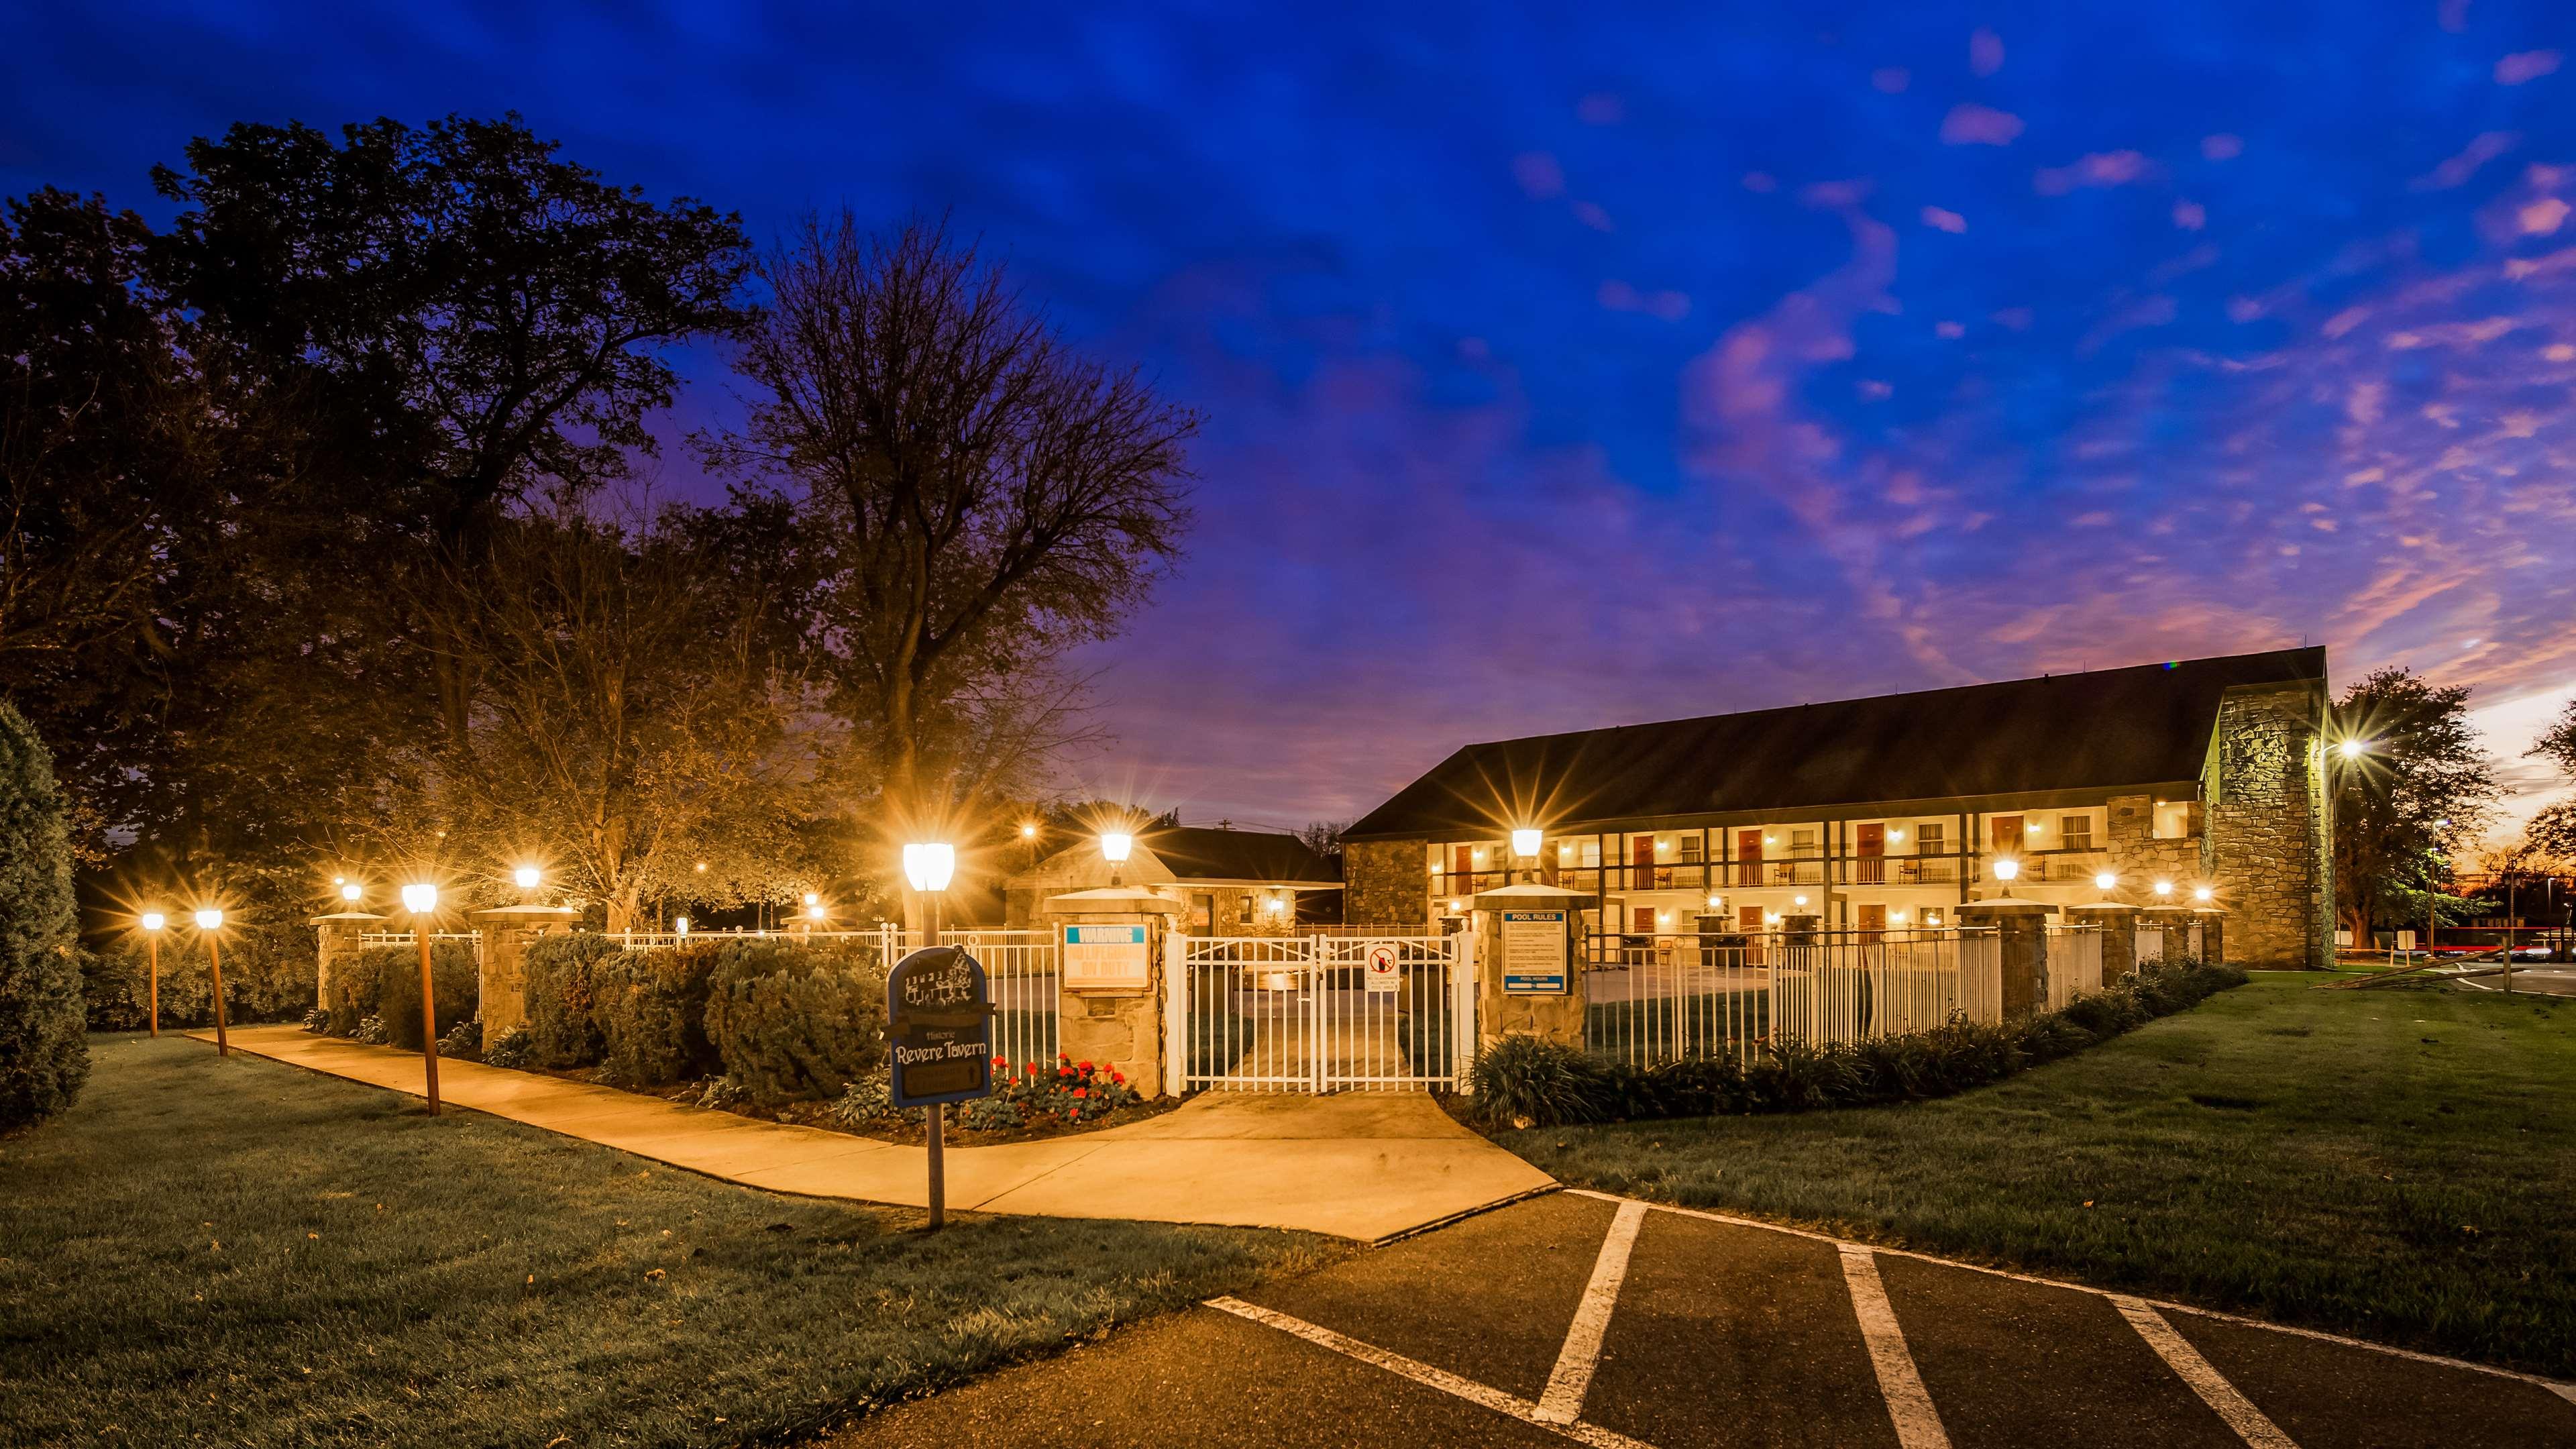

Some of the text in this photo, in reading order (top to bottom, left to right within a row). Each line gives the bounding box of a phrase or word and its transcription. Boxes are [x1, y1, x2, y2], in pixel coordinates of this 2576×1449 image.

[1078, 927, 1133, 943] WARNING
[1068, 946, 1084, 960] NO
[1082, 961, 1129, 976] ON DUTY
[895, 1040, 987, 1065] Revere Tavern
